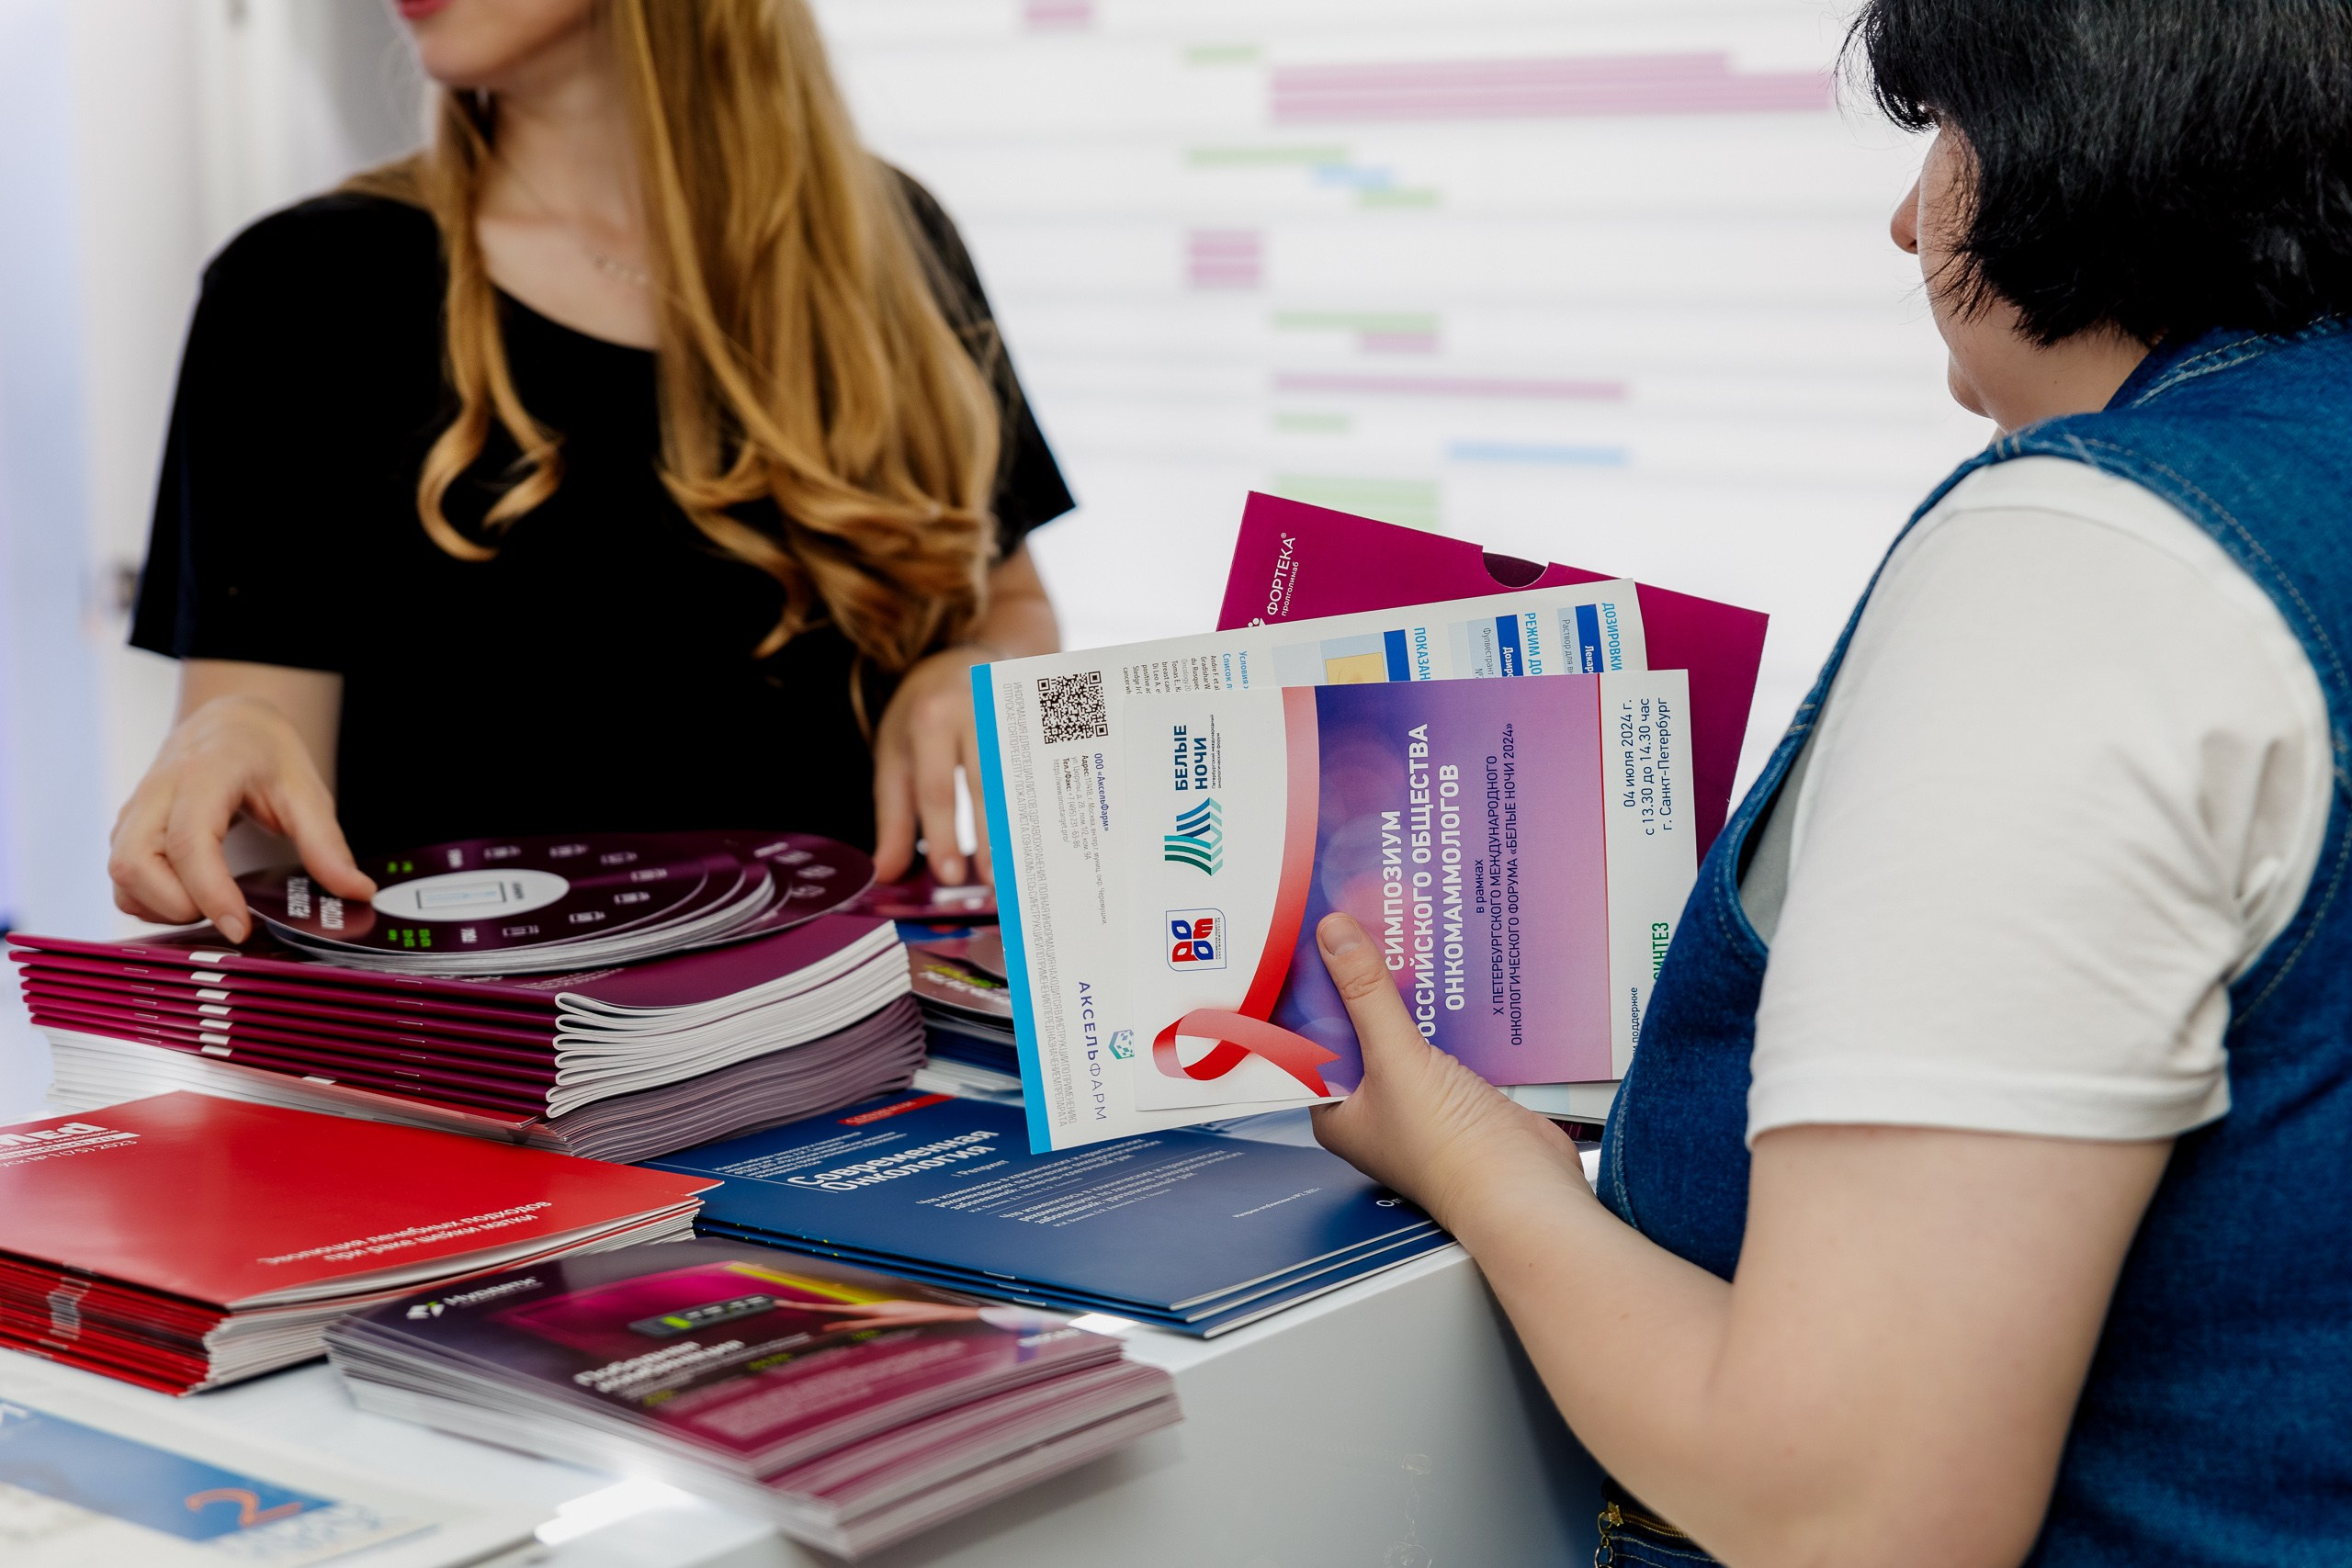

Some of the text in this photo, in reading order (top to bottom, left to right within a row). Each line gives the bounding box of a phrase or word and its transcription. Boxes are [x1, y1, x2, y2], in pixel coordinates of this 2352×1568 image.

[1282, 562, 1298, 615] пролголимаб
[1482, 628, 1493, 674] Фулвестрант
[1525, 613, 1540, 656] РЕЖИМ
[1563, 620, 1574, 664] Раствор для
[1602, 604, 1622, 671] ДОЗИРОВКИ
[1132, 665, 1140, 684] Sledge
[1141, 665, 1149, 686] positive
[1181, 659, 1190, 683] Oncology
[1222, 653, 1232, 682] Список
[1238, 650, 1250, 684] Условия
[1003, 683, 1018, 735] ОТПУСКАЕТСЯ
[1013, 682, 1027, 733] ИНФОРМАЦИЯ
[1640, 698, 1650, 721] час
[1018, 735, 1030, 752] ДЛЯ
[1080, 755, 1090, 776] Адрес:
[1174, 726, 1189, 790] БЕЛЫЕ
[1194, 738, 1207, 789] НОЧИ
[1620, 699, 1635, 807] 04 июля 2024 г.
[1639, 726, 1651, 761] 14.30
[1656, 698, 1672, 830] г. Санкт-Петербург
[1021, 751, 1037, 809] СПЕЦИАЛИСТОВ
[1094, 753, 1109, 830] ООО «АксельФарм»
[1643, 766, 1654, 784] до
[1487, 756, 1502, 886] МЕЖДУНАРОДНОГО
[1641, 788, 1654, 823] 13.30
[1022, 834, 1036, 892] ОЗНАКОМЬТЕСЬ
[1408, 724, 1435, 1044] ОССИЙСКОГО ОБЩЕСТВА
[1440, 765, 1464, 1010] ОНКОМАММОЛОГОВ
[1476, 860, 1487, 903] рамках
[1503, 724, 1521, 1045] ОНКОЛОГИЧЕСКОГО ФОРУМА «БЕЛЫЕ НОЧИ 2024»
[1039, 883, 1051, 912] ПОЛНАЯ
[1382, 812, 1404, 970] СИМПОЗИУМ
[1029, 897, 1045, 948] ИНСТРУКЦИЕЙ
[1041, 914, 1056, 964] ИНФОРМАЦИЯ
[1490, 890, 1503, 1003] ПЕТЕРБУРГСКОГО
[1049, 965, 1062, 1009] НАХОДИТСЯ
[1044, 1008, 1056, 1032] ПЕРЕД
[1055, 1016, 1069, 1063] ИНСТРУКЦИИ
[1629, 986, 1642, 1043] поддержке
[1047, 1031, 1063, 1085] НАЗНАЧЕНИЕМ
[1080, 982, 1106, 1119] АКСЕЛЬФАРМ
[787, 1129, 1001, 1188] Современная
[820, 1143, 996, 1192] Онкология
